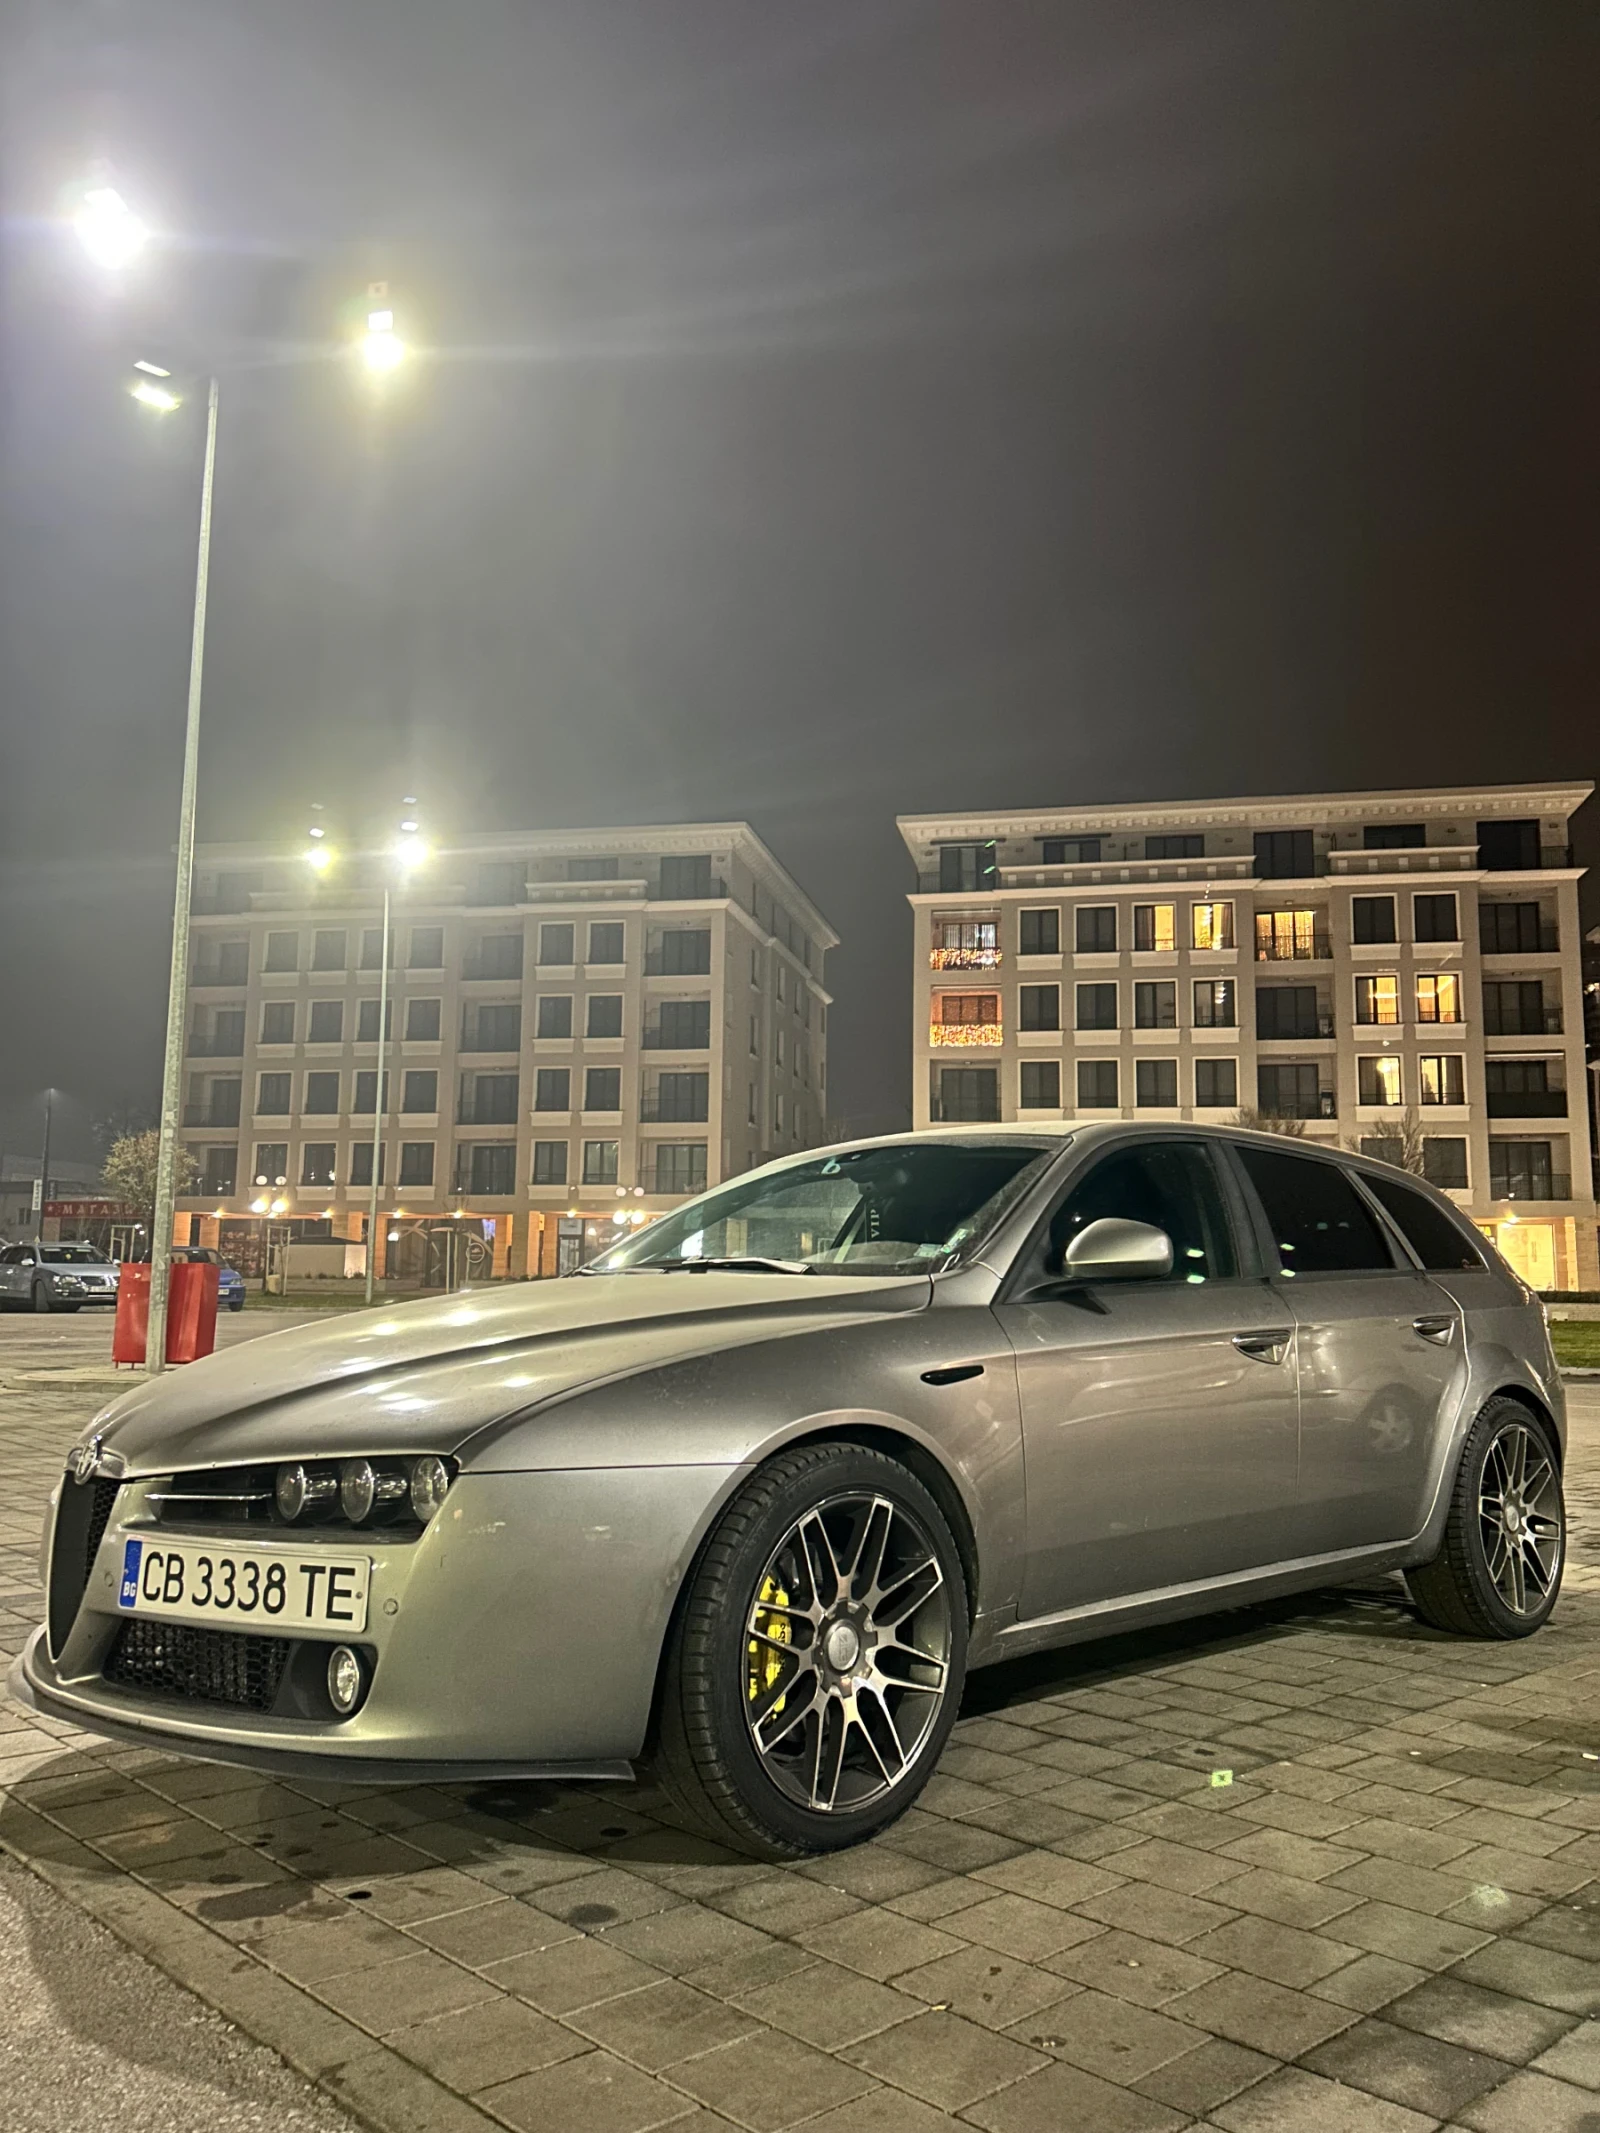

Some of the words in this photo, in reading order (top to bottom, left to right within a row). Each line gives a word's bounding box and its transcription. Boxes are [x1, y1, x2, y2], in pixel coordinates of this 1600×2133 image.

[870, 1209, 880, 1239] VIP
[123, 1581, 136, 1597] BG
[143, 1551, 184, 1604] CB
[191, 1556, 286, 1614] 3338
[300, 1564, 356, 1621] TE
